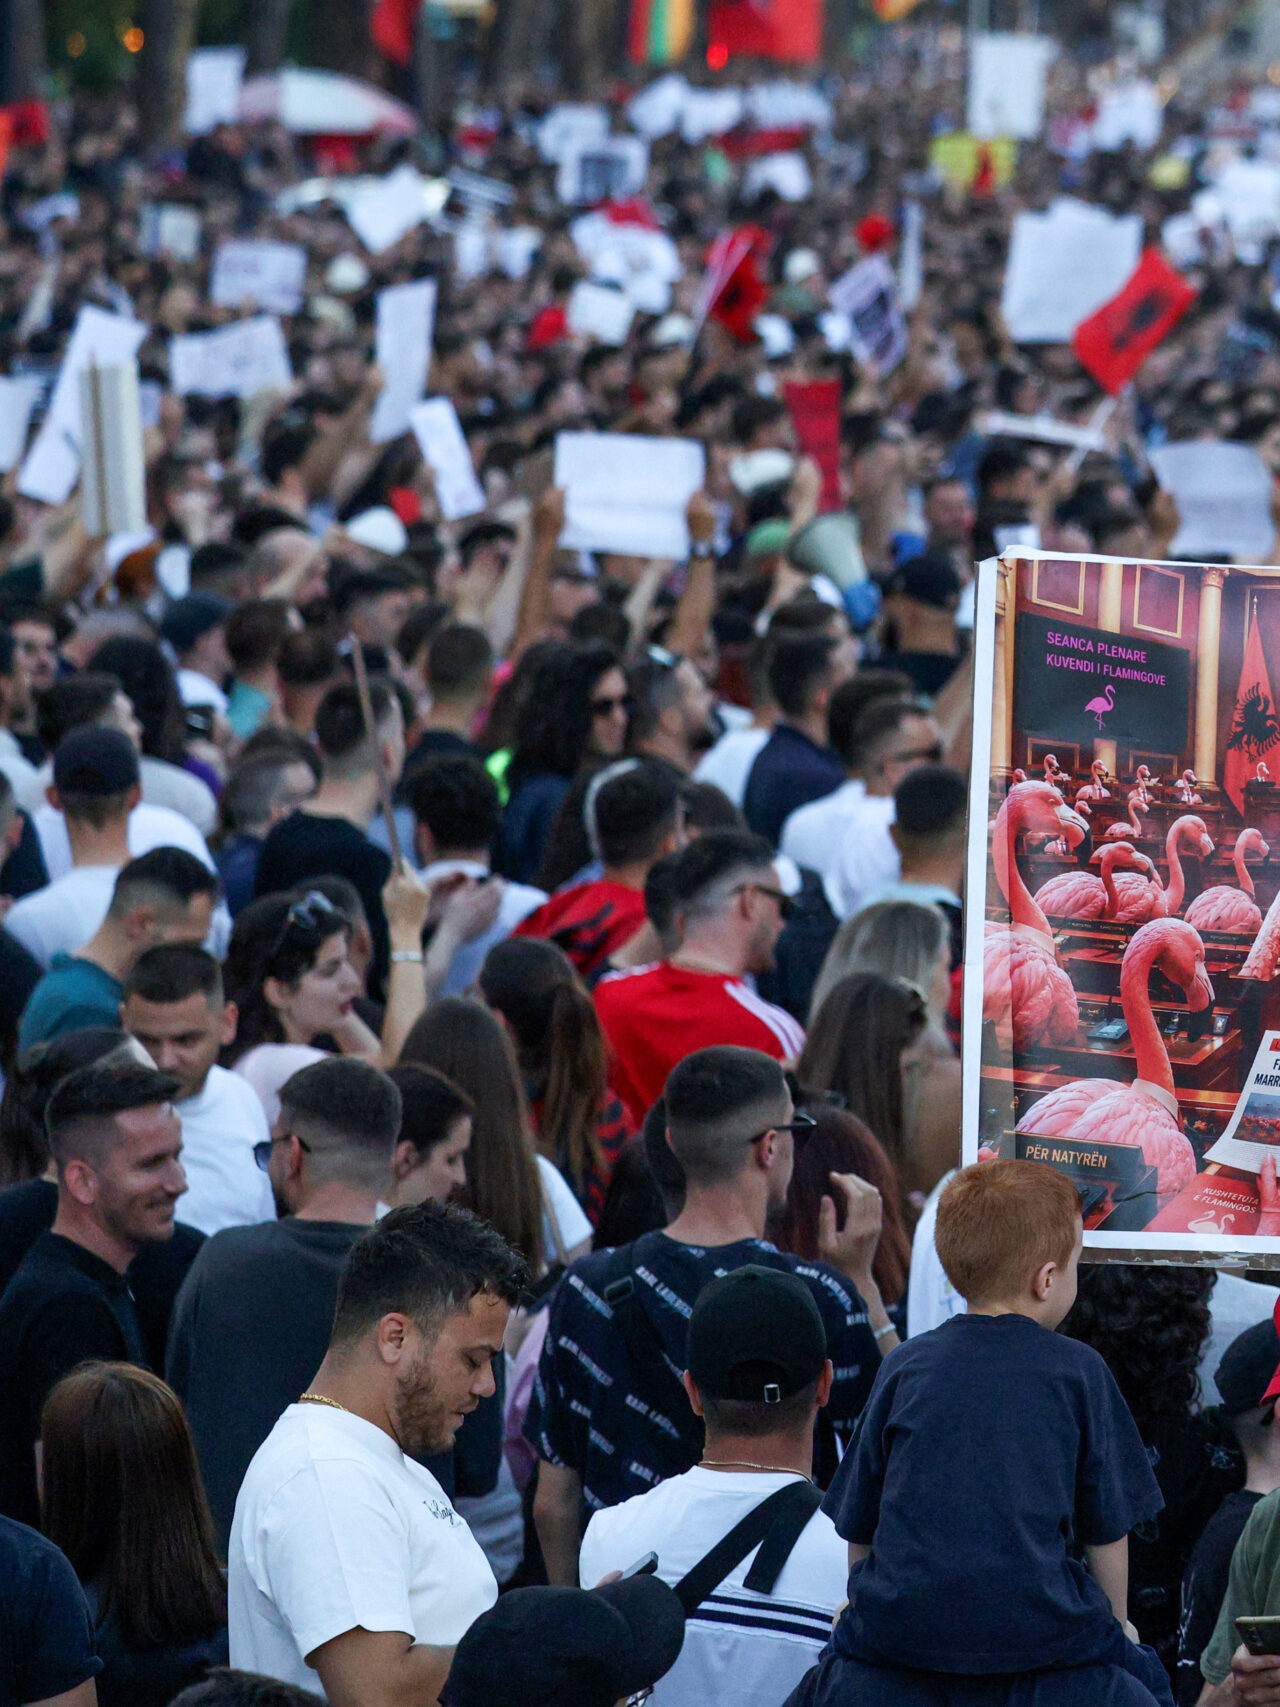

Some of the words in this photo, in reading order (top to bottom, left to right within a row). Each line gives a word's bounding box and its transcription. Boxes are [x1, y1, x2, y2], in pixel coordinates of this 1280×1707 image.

[1047, 631, 1094, 653] SEANCA
[1097, 642, 1147, 663] PLENARE
[1046, 653, 1094, 673] KUVENDI
[1097, 663, 1100, 674] I
[1103, 664, 1166, 686] FLAMINGOVE
[1026, 1144, 1050, 1160] PËR
[1051, 1148, 1107, 1169] NATYRËN
[1201, 1196, 1256, 1214] FLAMINGOS
[1203, 1187, 1259, 1205] KUSHTETUTA
